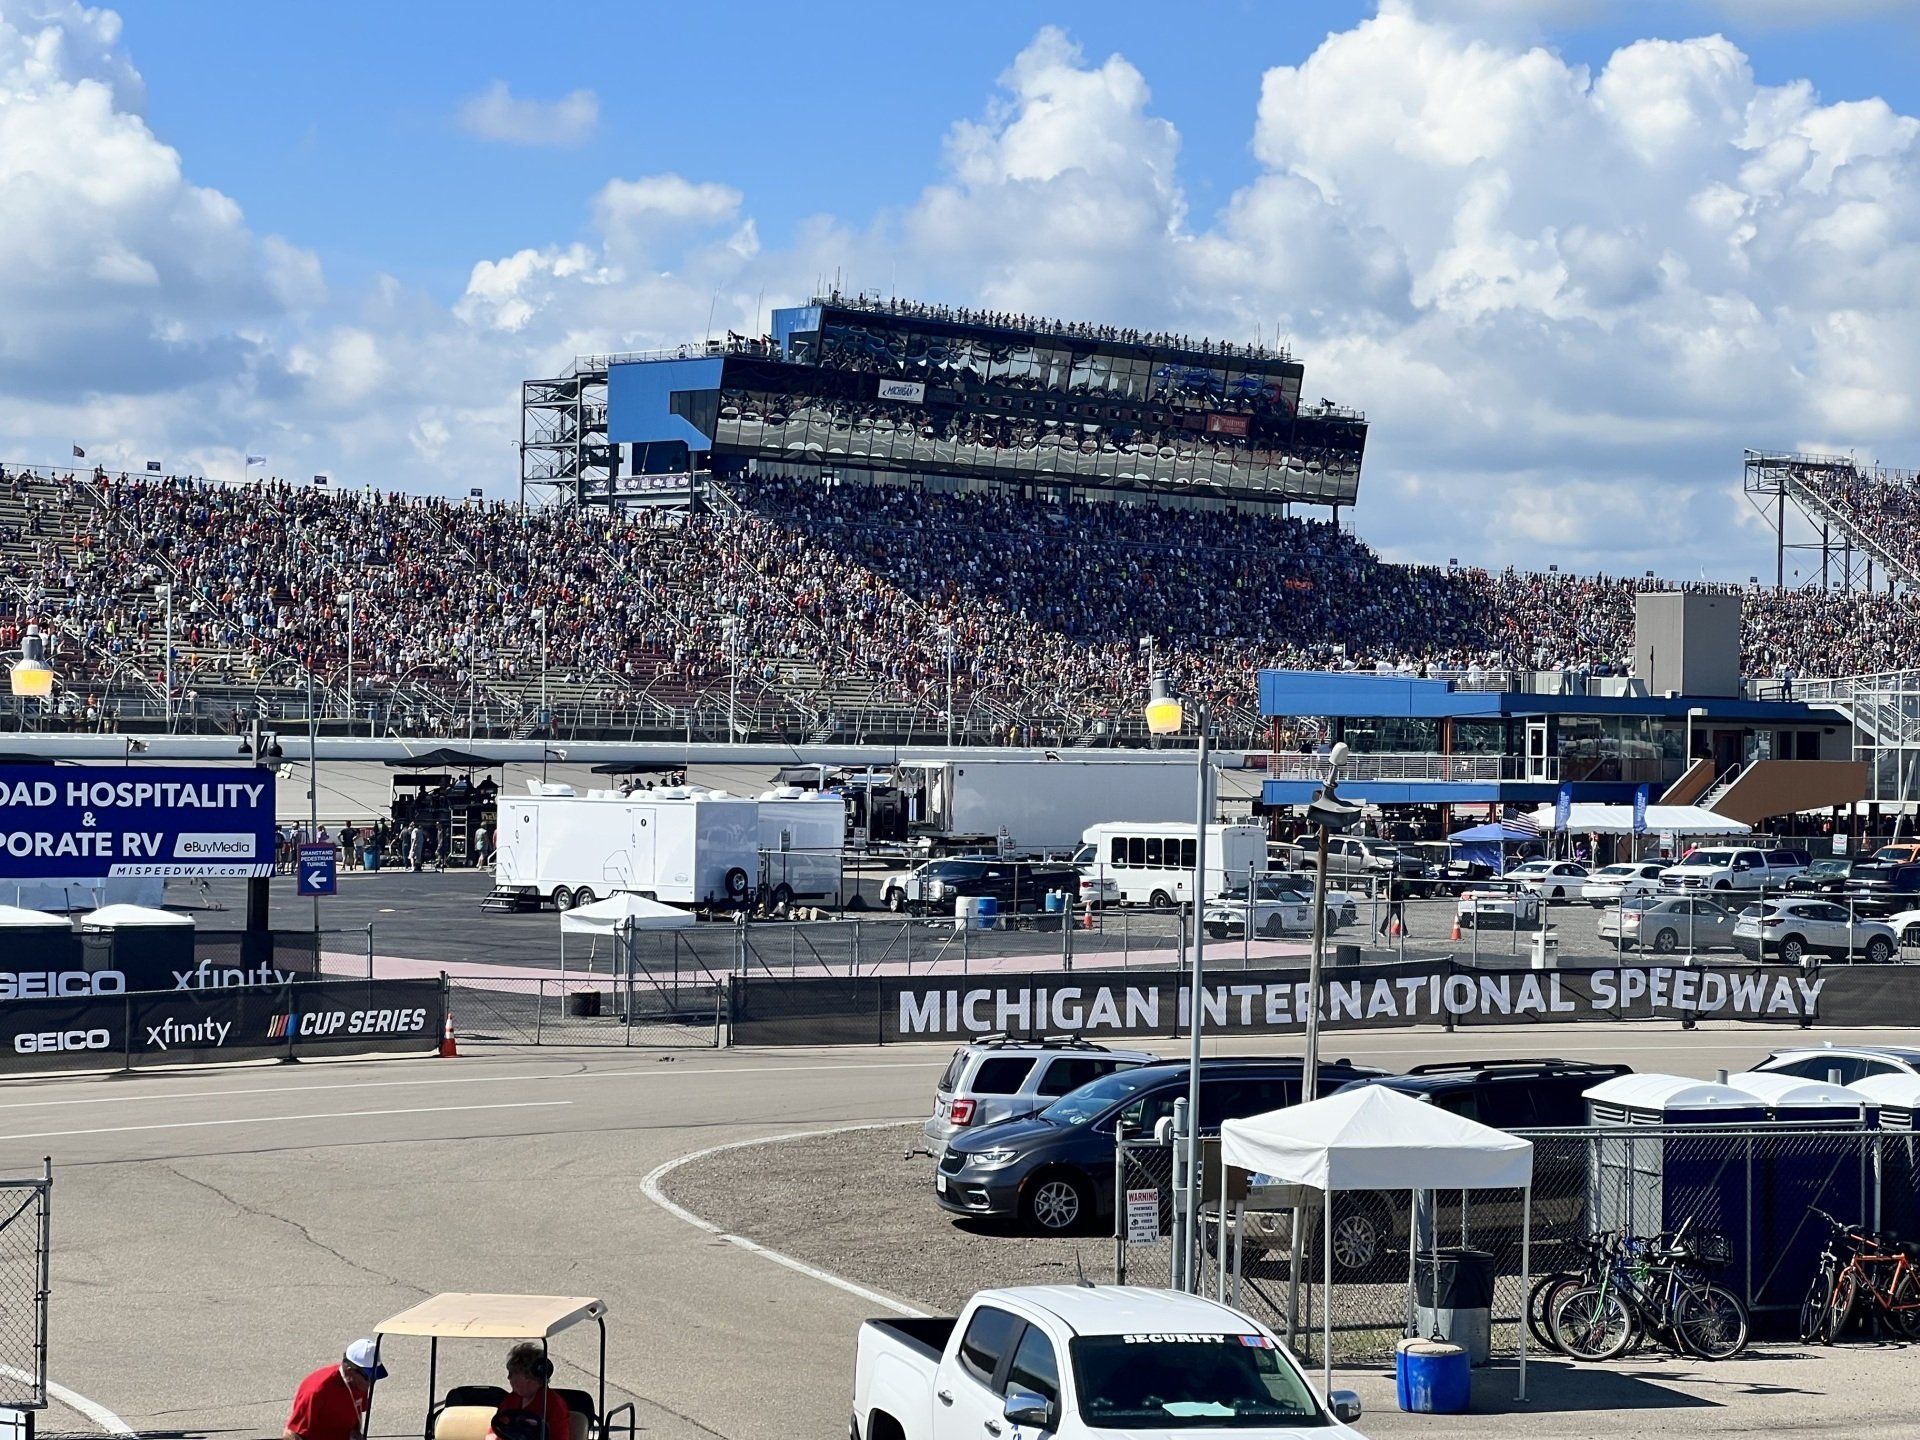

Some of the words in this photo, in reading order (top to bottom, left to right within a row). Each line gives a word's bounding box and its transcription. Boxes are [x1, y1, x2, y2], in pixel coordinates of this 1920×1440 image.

[887, 386, 914, 397] MICHIGAN
[66, 781, 265, 808] HOSPITALITY
[82, 811, 97, 827] &
[122, 832, 164, 857] RV
[183, 840, 250, 853] eBuyMedia
[116, 866, 247, 876] MISPEEDWAY.com
[0, 970, 125, 1000] GEICO
[899, 986, 1159, 1034] MICHIGAN
[1178, 973, 1576, 1027] INTERNATIONAL
[1590, 967, 1826, 1015] SPEEDWAY
[146, 1016, 232, 1051] xfinity
[300, 1011, 346, 1036] CUP
[347, 1008, 427, 1034] SERIES
[14, 1028, 111, 1054] GEICO
[1128, 1192, 1157, 1202] WARNING
[1123, 1334, 1225, 1344] SECURITY
